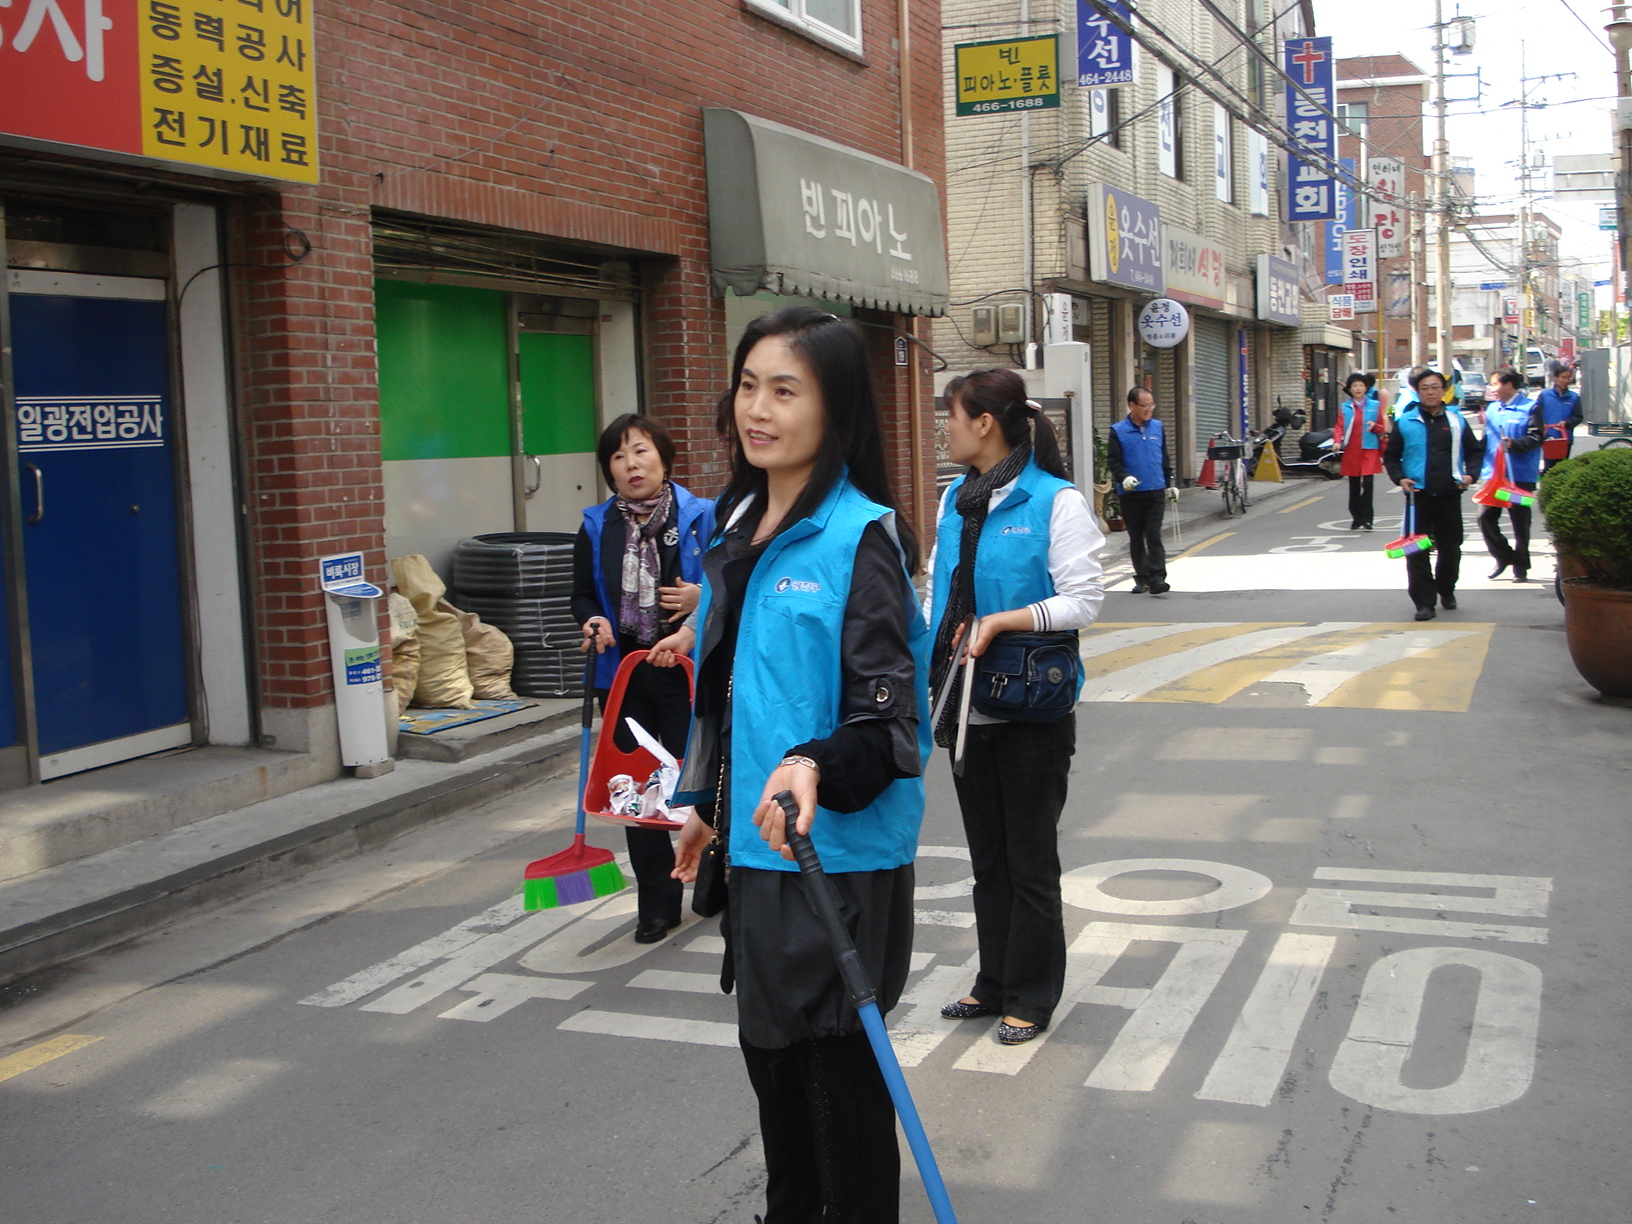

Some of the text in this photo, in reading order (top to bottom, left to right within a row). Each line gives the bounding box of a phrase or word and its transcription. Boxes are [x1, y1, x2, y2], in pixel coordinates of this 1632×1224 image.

[149, 0, 306, 73] 동력공사
[998, 46, 1021, 66] 빈
[1079, 69, 1132, 86] 464-2448
[973, 97, 1044, 112] 466-1688
[153, 107, 310, 168] 전기재료
[800, 178, 912, 261] 빈 피아노
[1119, 205, 1161, 268] 옷수선
[1347, 234, 1369, 256] 도장
[1198, 247, 1223, 288] 식당
[1349, 257, 1368, 280] 인쇄
[1332, 295, 1352, 306] 식품
[1141, 312, 1182, 329] 옷수선
[1332, 307, 1352, 319] 담배
[17, 404, 163, 441] 일광전업공사
